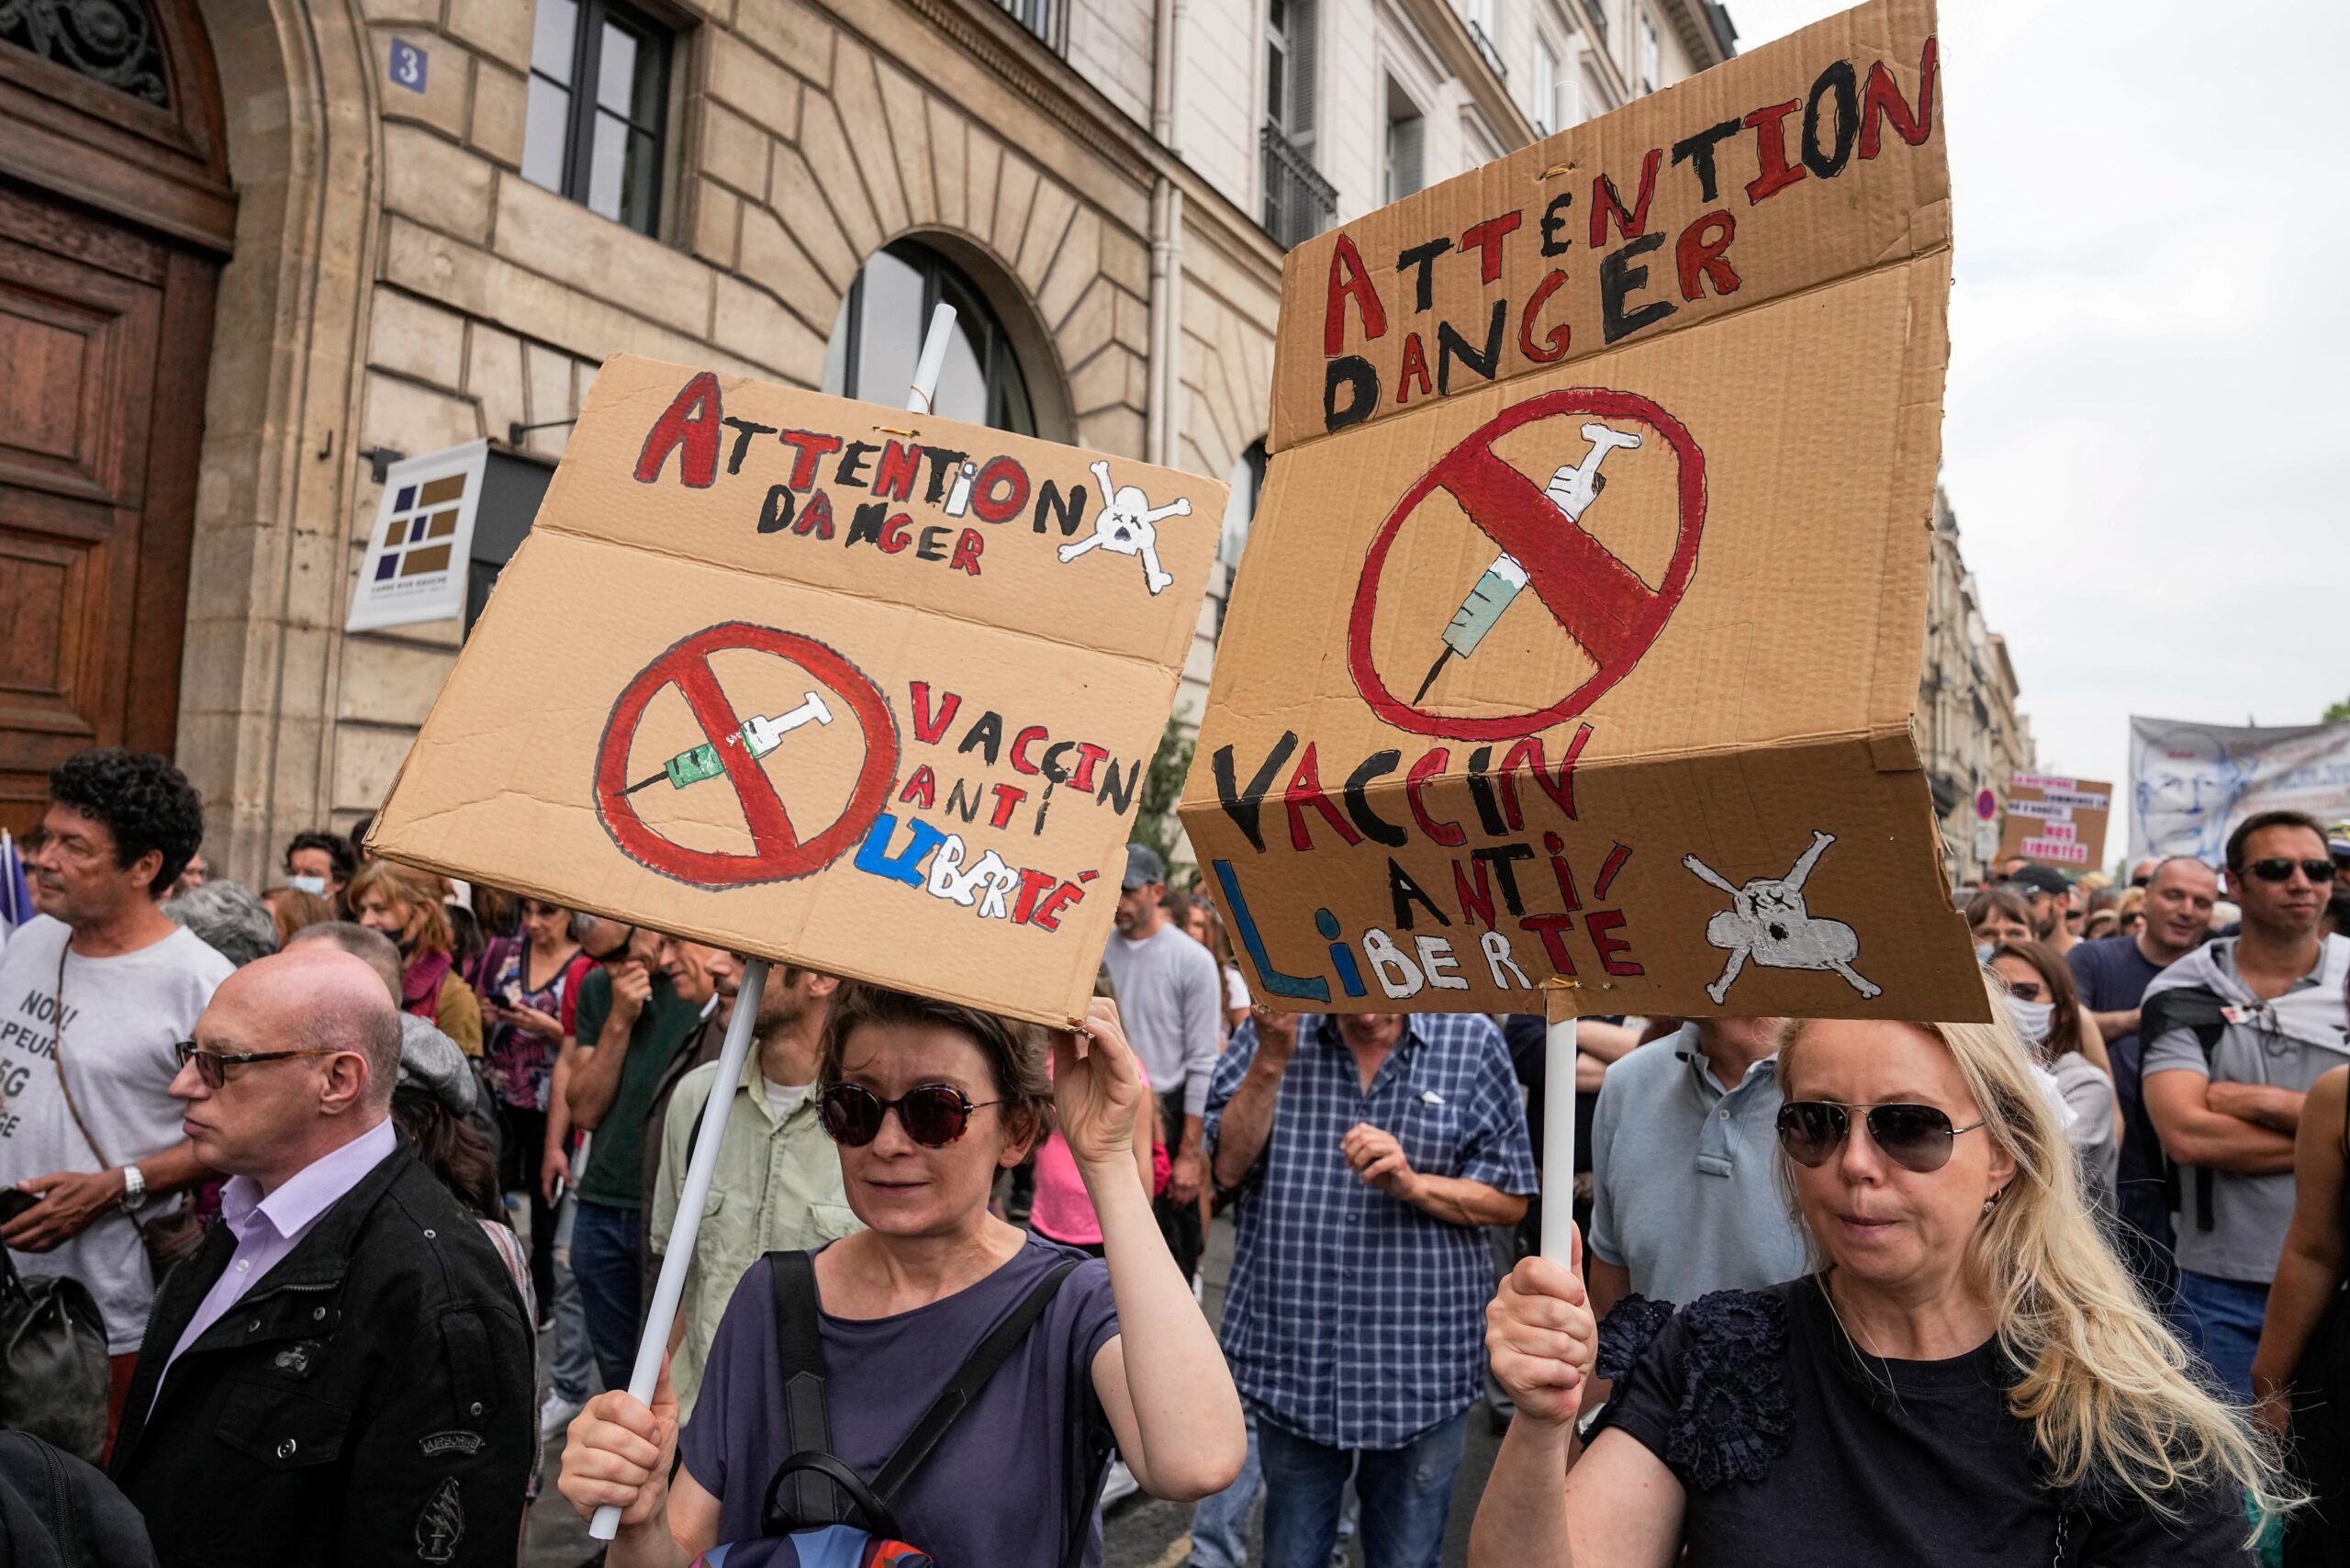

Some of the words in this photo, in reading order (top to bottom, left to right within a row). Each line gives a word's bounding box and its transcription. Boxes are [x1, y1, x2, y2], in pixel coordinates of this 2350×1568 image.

[399, 47, 419, 84] 3
[1325, 34, 1938, 357] ATTENTION
[1325, 207, 1741, 434] DANGER
[756, 484, 985, 576] DANGER
[909, 680, 1141, 816] VACCIN
[2045, 825, 2073, 841] NOS
